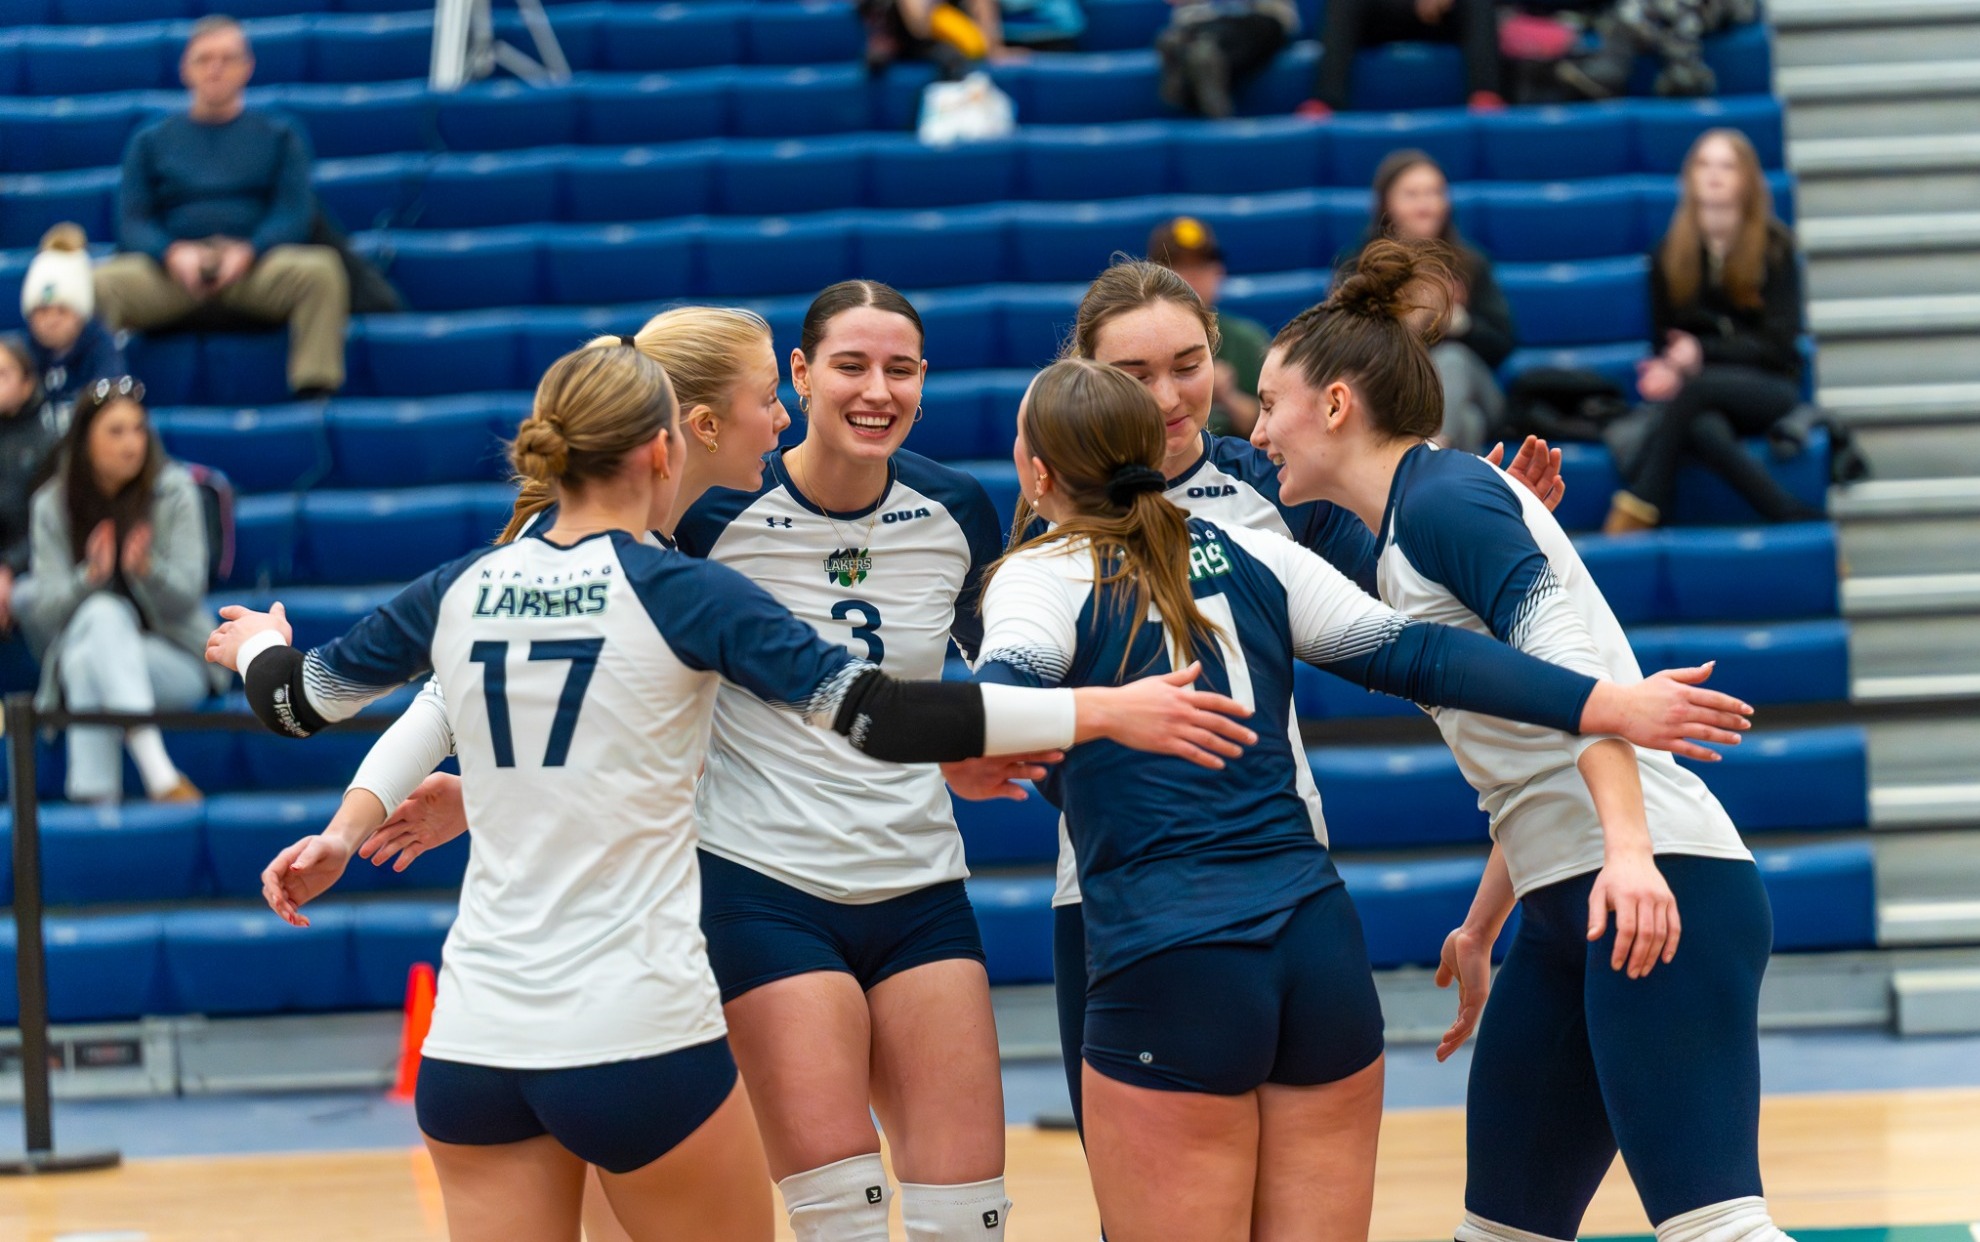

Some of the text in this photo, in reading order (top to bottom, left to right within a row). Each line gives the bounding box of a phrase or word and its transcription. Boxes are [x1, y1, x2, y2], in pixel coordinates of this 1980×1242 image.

[1186, 484, 1238, 498] OUA
[881, 507, 931, 524] OUA
[472, 580, 611, 619] LAKERS
[831, 599, 885, 667] 3
[469, 637, 606, 768] 17
